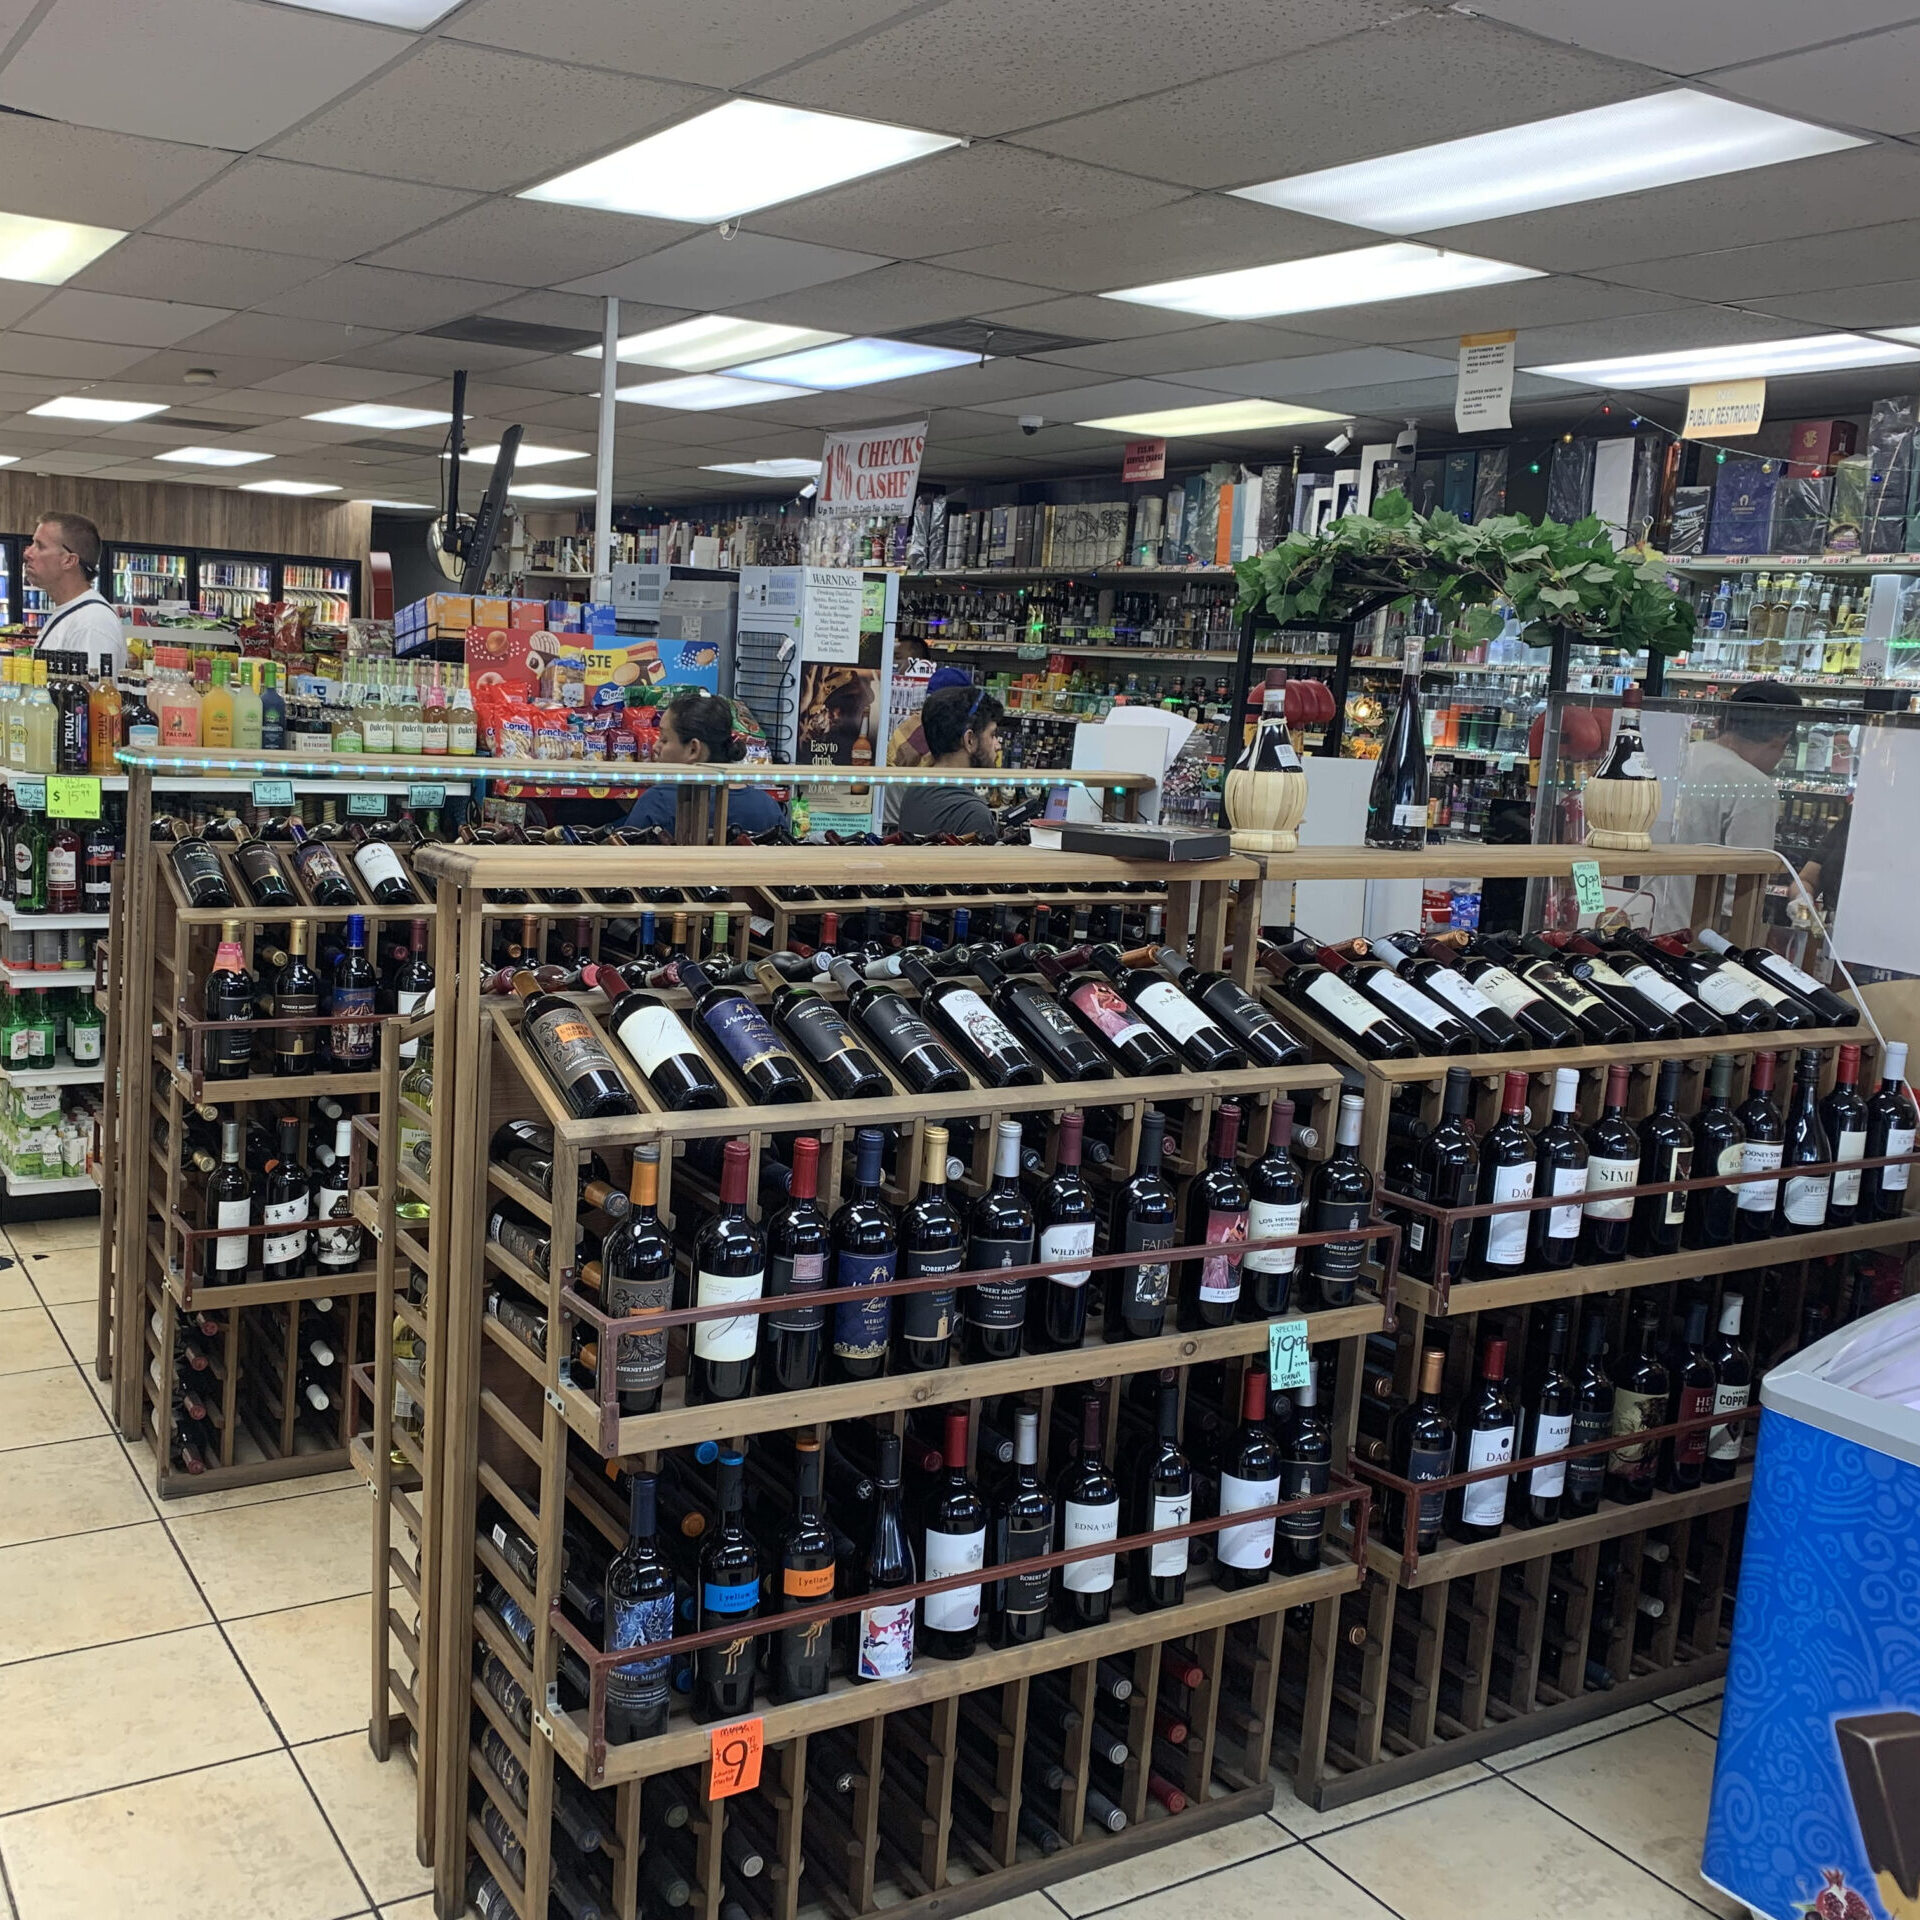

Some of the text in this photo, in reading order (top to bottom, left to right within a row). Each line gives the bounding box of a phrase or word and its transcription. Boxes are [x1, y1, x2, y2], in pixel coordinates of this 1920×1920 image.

[1689, 403, 1760, 426] PUBLIC RESTROOMS
[858, 435, 925, 469] CHECKS
[821, 444, 852, 502] 1%
[857, 470, 915, 500] CASHE
[812, 574, 857, 586] WARNING:
[65, 710, 74, 746] TRULY
[98, 712, 107, 746] TRULY
[810, 740, 838, 754] Easy to
[1600, 1169, 1634, 1183] SIMI
[1051, 1247, 1075, 1256] WILD
[1324, 1243, 1347, 1251] ROBERT
[920, 1264, 945, 1272] ROBERT
[977, 1284, 1000, 1294] ROBERT
[1276, 1324, 1302, 1334] SPECIAL
[1696, 1397, 1713, 1407] HE
[1074, 1522, 1099, 1531] EDNA
